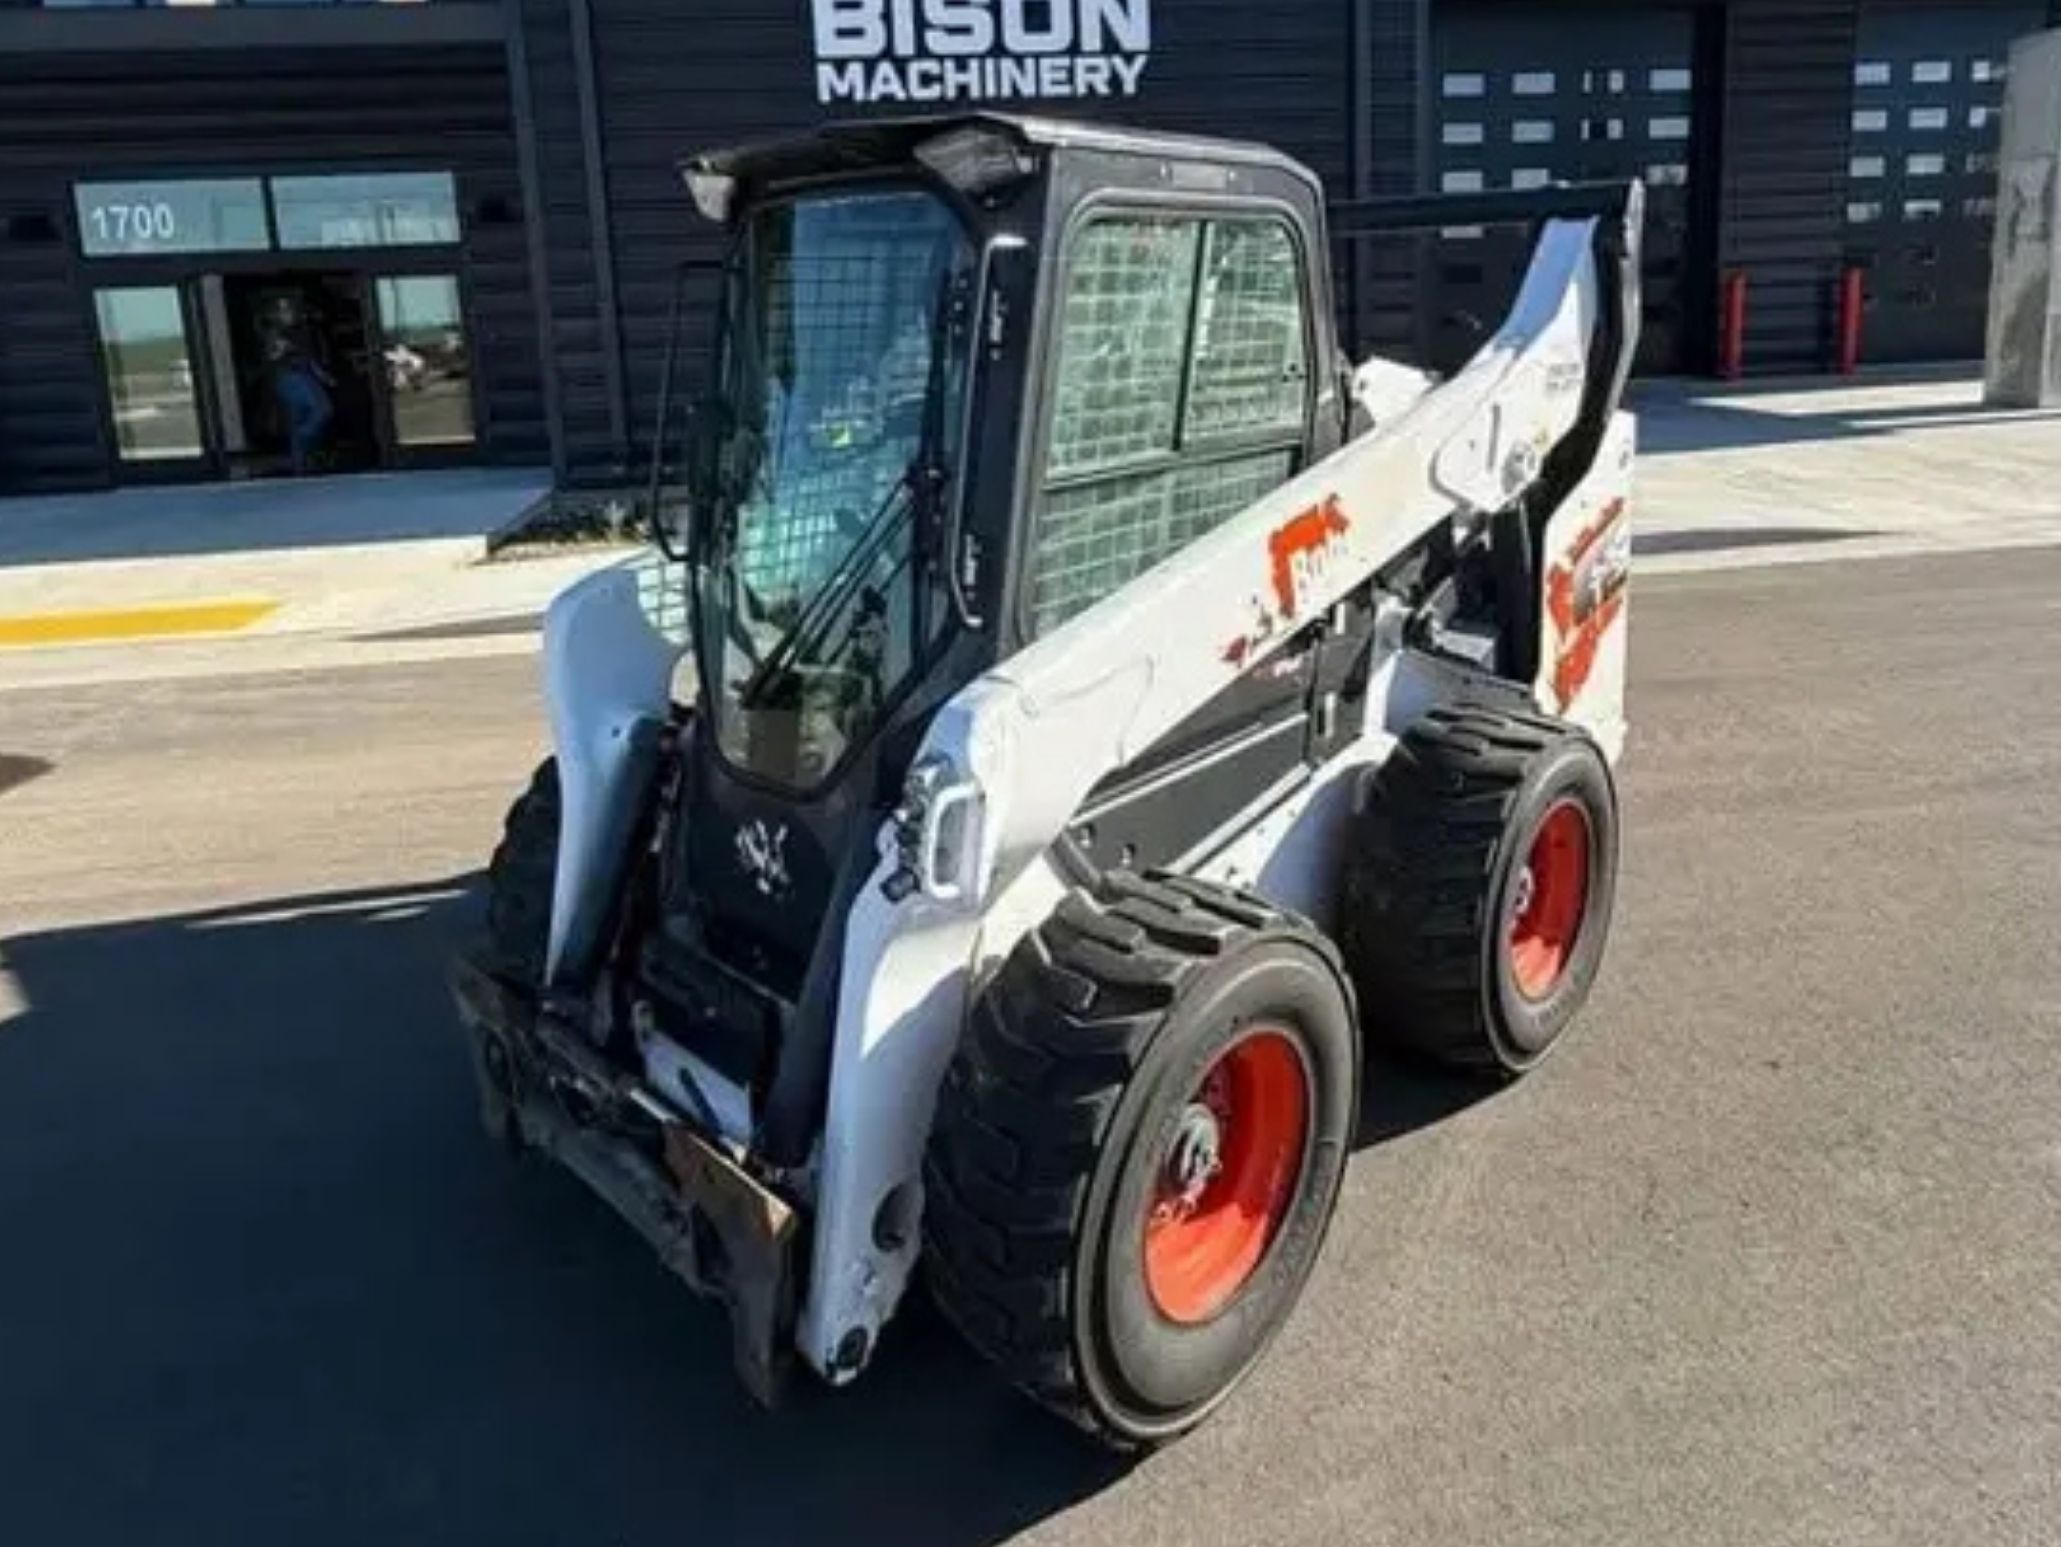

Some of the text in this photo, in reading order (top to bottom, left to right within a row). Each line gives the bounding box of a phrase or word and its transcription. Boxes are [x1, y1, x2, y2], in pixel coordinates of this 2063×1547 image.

[812, 0, 1151, 57] BISON
[816, 54, 1148, 103] MACHINERY
[91, 202, 174, 240] 1700
